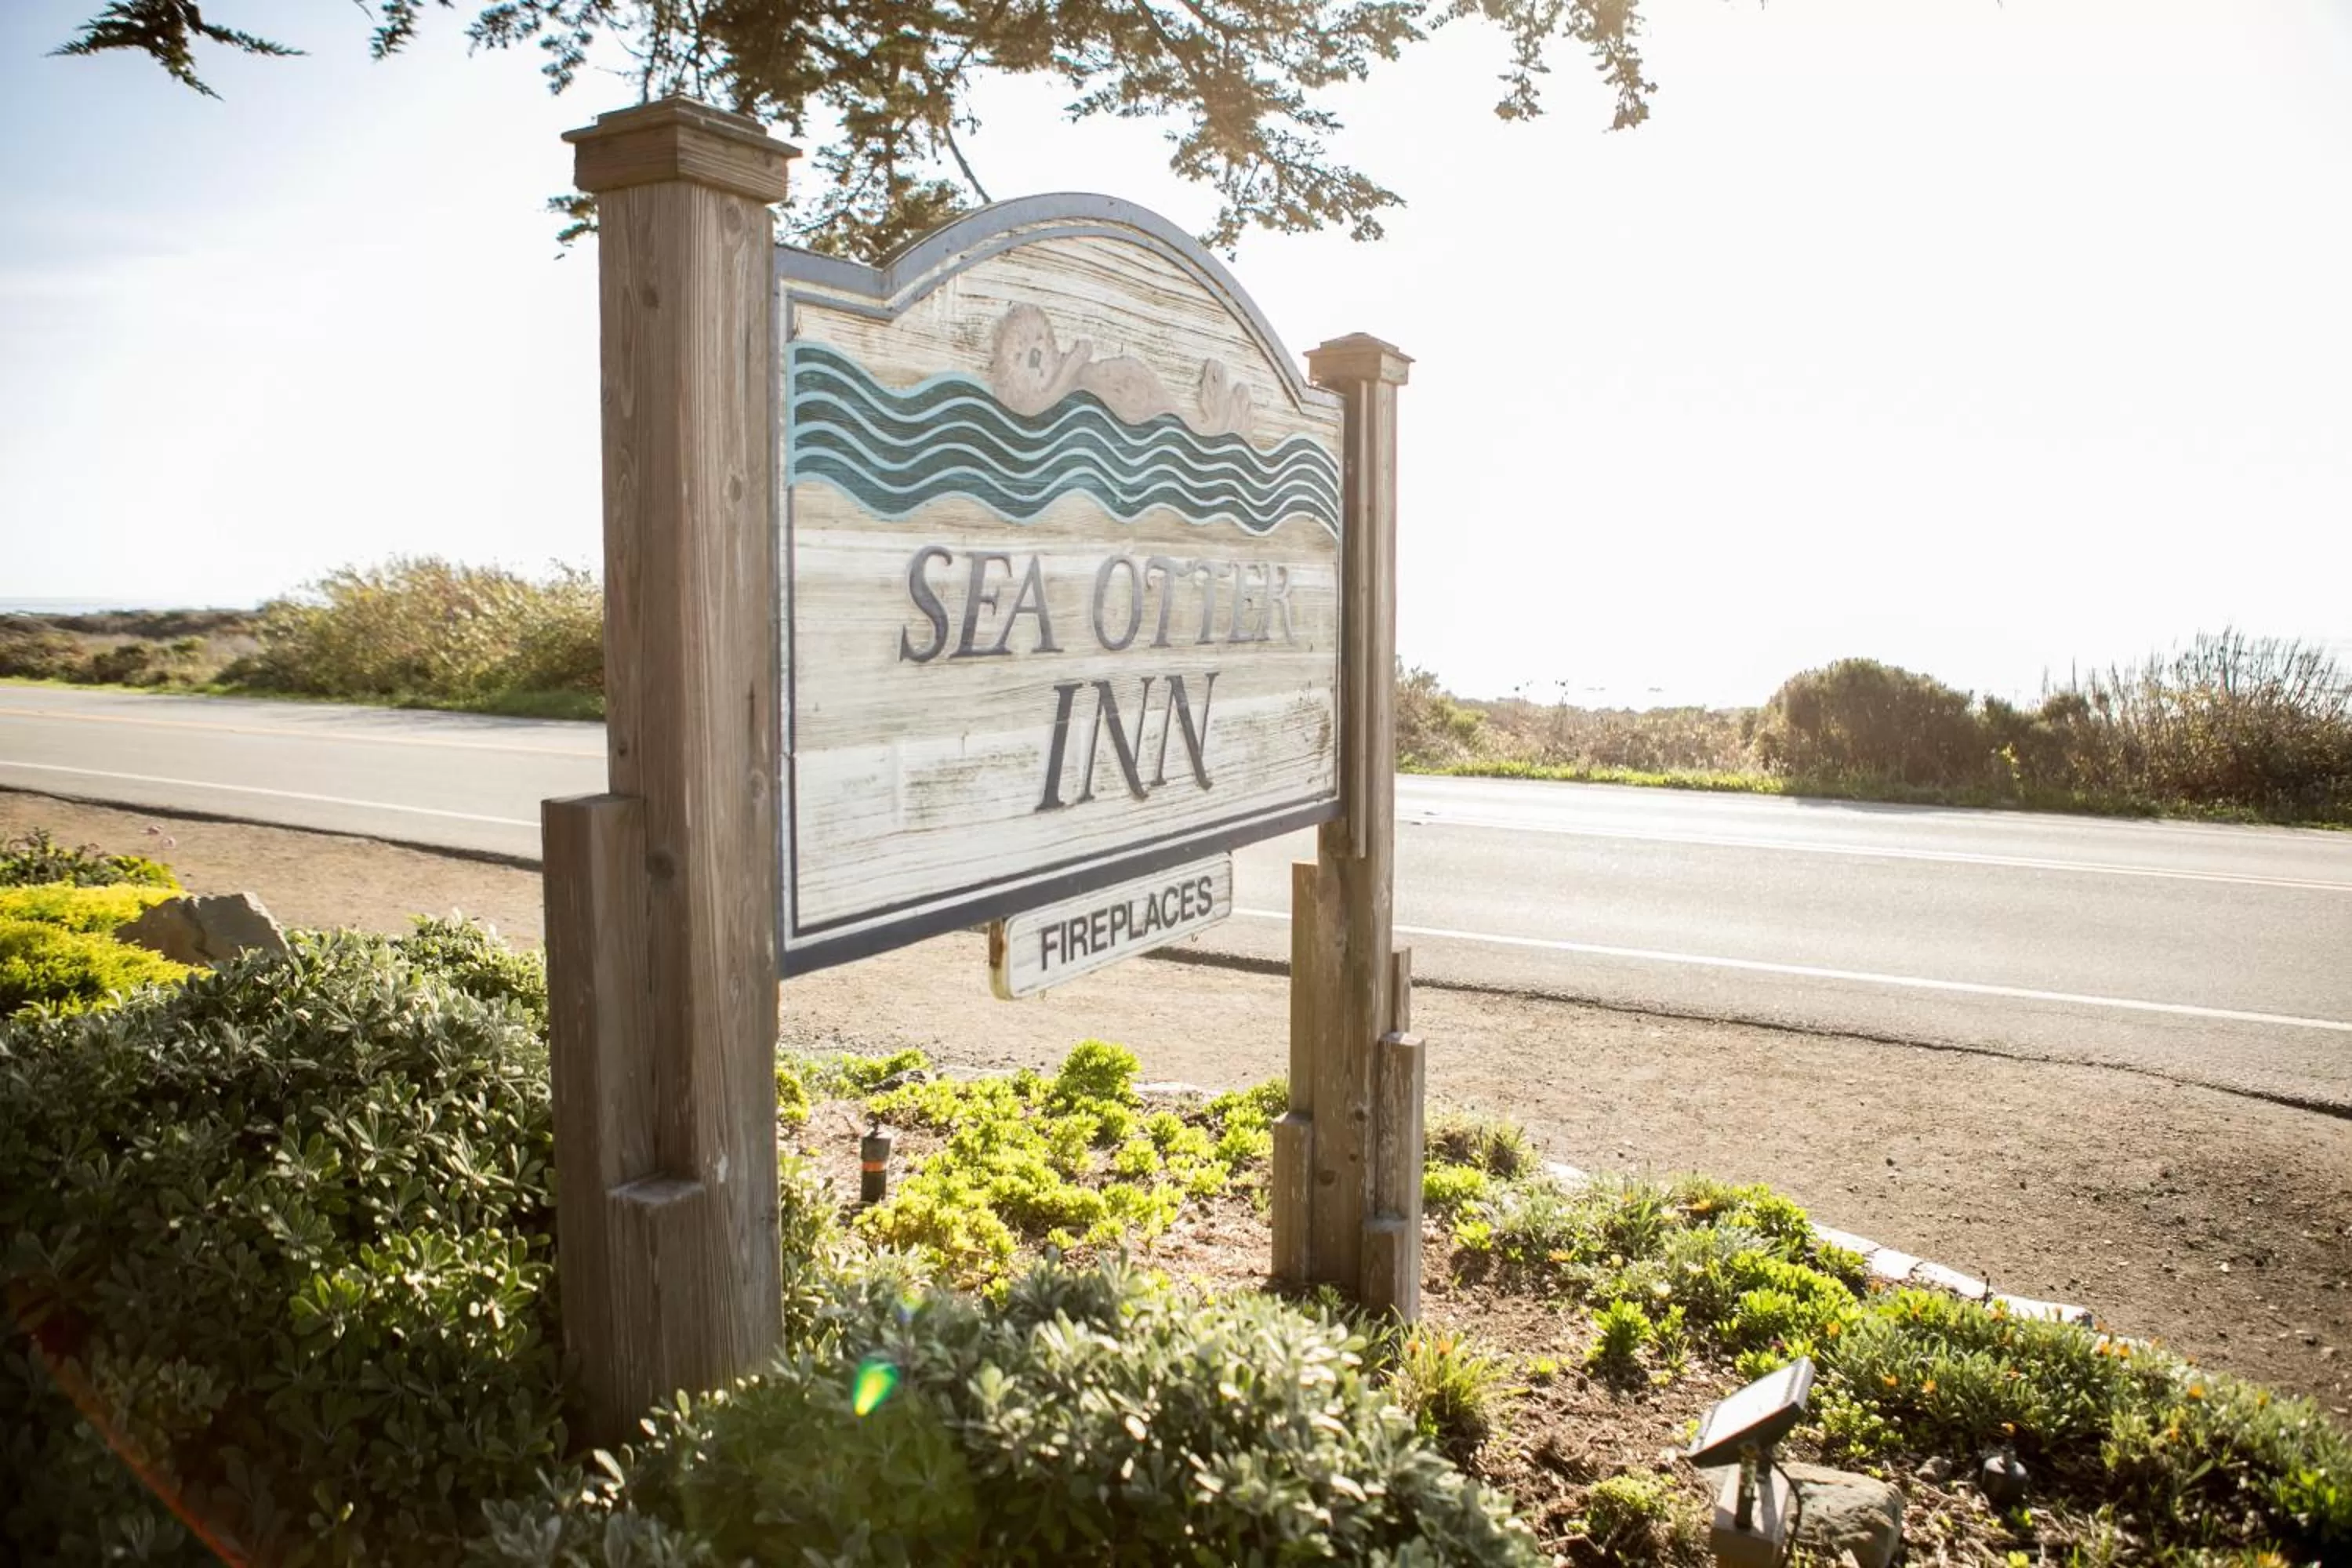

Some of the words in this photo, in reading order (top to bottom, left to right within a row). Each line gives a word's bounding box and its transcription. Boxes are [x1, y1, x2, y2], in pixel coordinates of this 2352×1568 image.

[899, 546, 1063, 662] SEA
[1093, 554, 1294, 651] OTTER
[1035, 672, 1220, 813] INN
[1040, 875, 1214, 971] FIREPLACES
